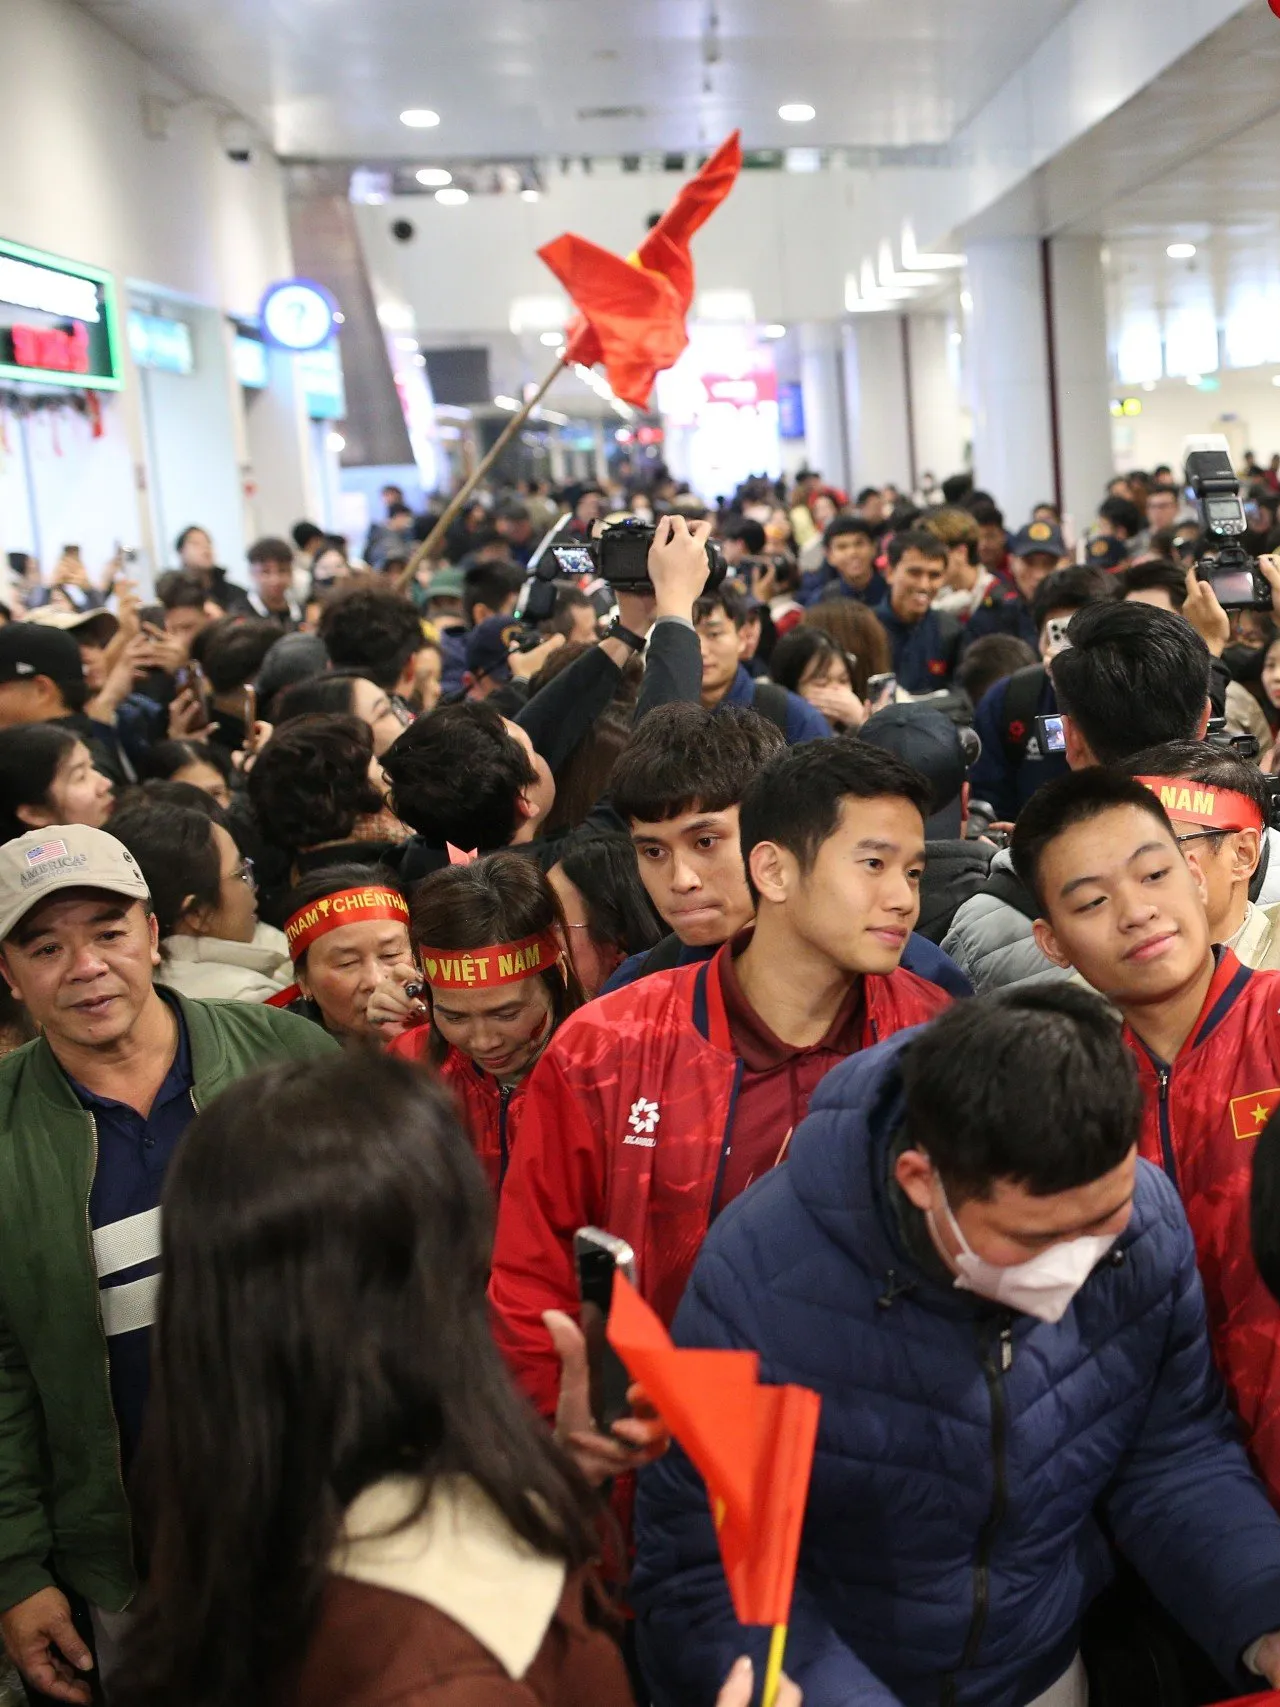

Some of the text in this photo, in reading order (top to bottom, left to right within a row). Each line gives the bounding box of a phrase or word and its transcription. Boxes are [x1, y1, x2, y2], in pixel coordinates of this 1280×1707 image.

[1160, 785, 1215, 816] NAM
[286, 908, 320, 943] TNAM
[440, 953, 489, 986] VIỆT
[498, 943, 540, 977] NAM
